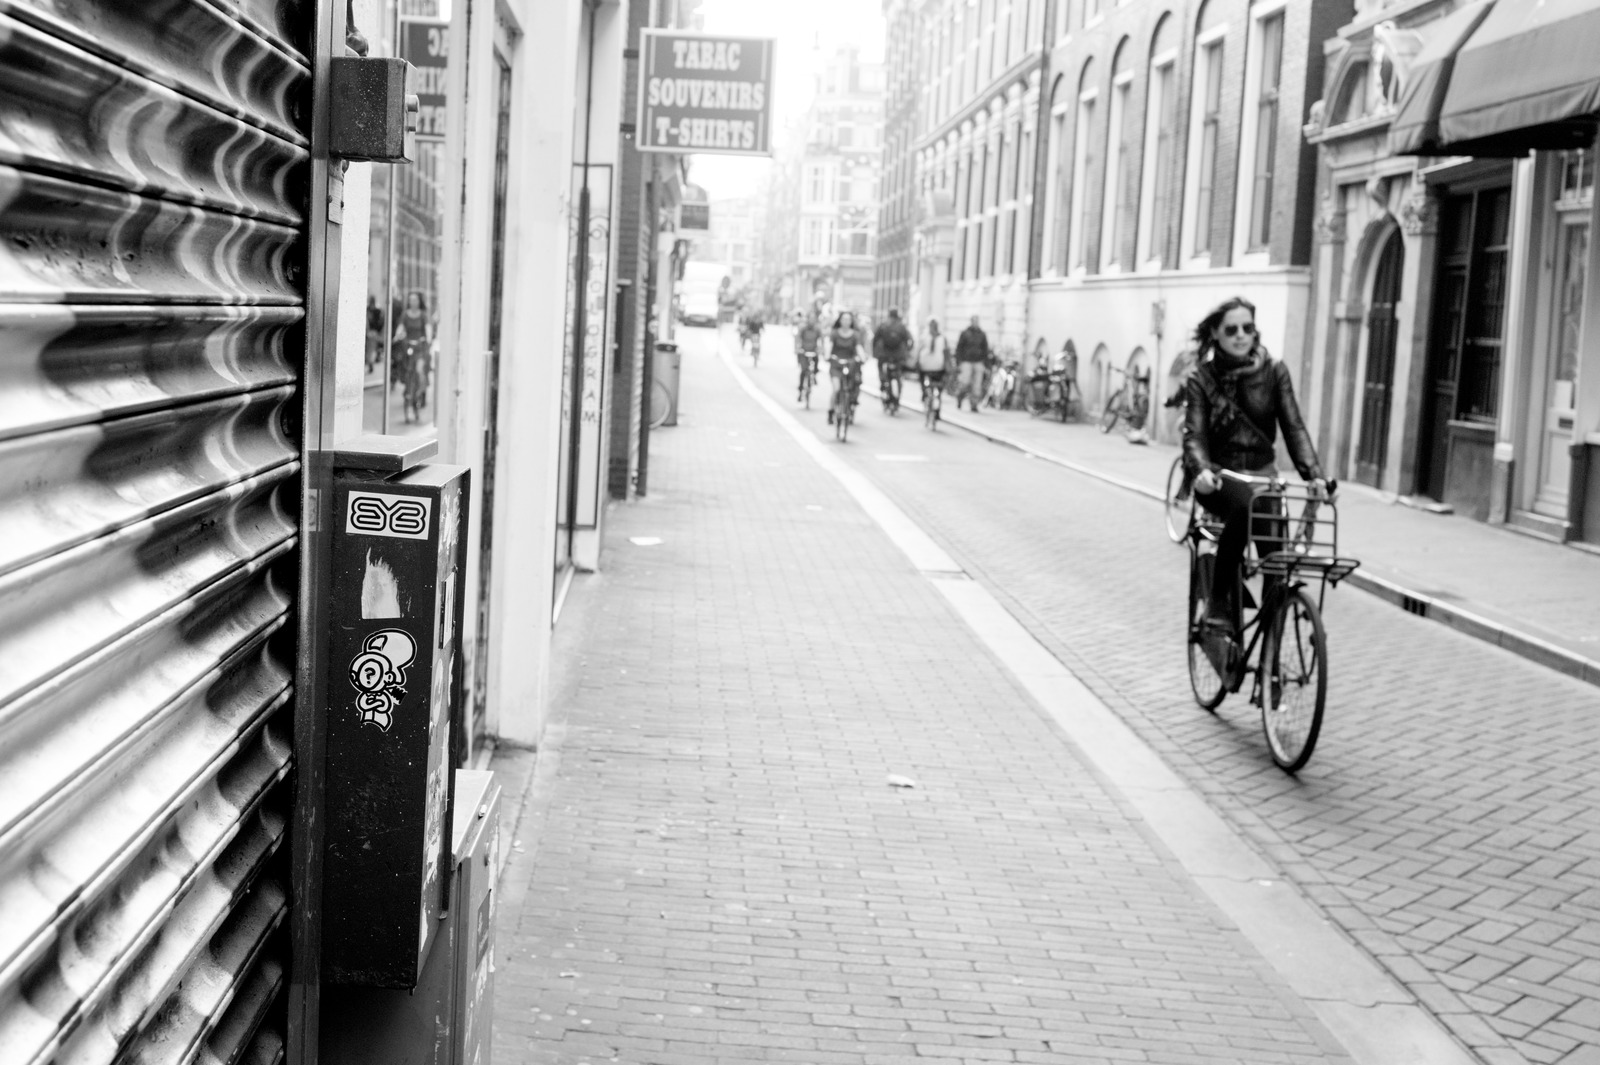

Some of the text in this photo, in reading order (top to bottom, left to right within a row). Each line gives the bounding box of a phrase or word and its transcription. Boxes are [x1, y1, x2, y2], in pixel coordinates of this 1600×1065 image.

[673, 40, 741, 71] TABAC
[648, 77, 765, 111] SOUVENIRS
[656, 116, 755, 149] T-SHIRTS
